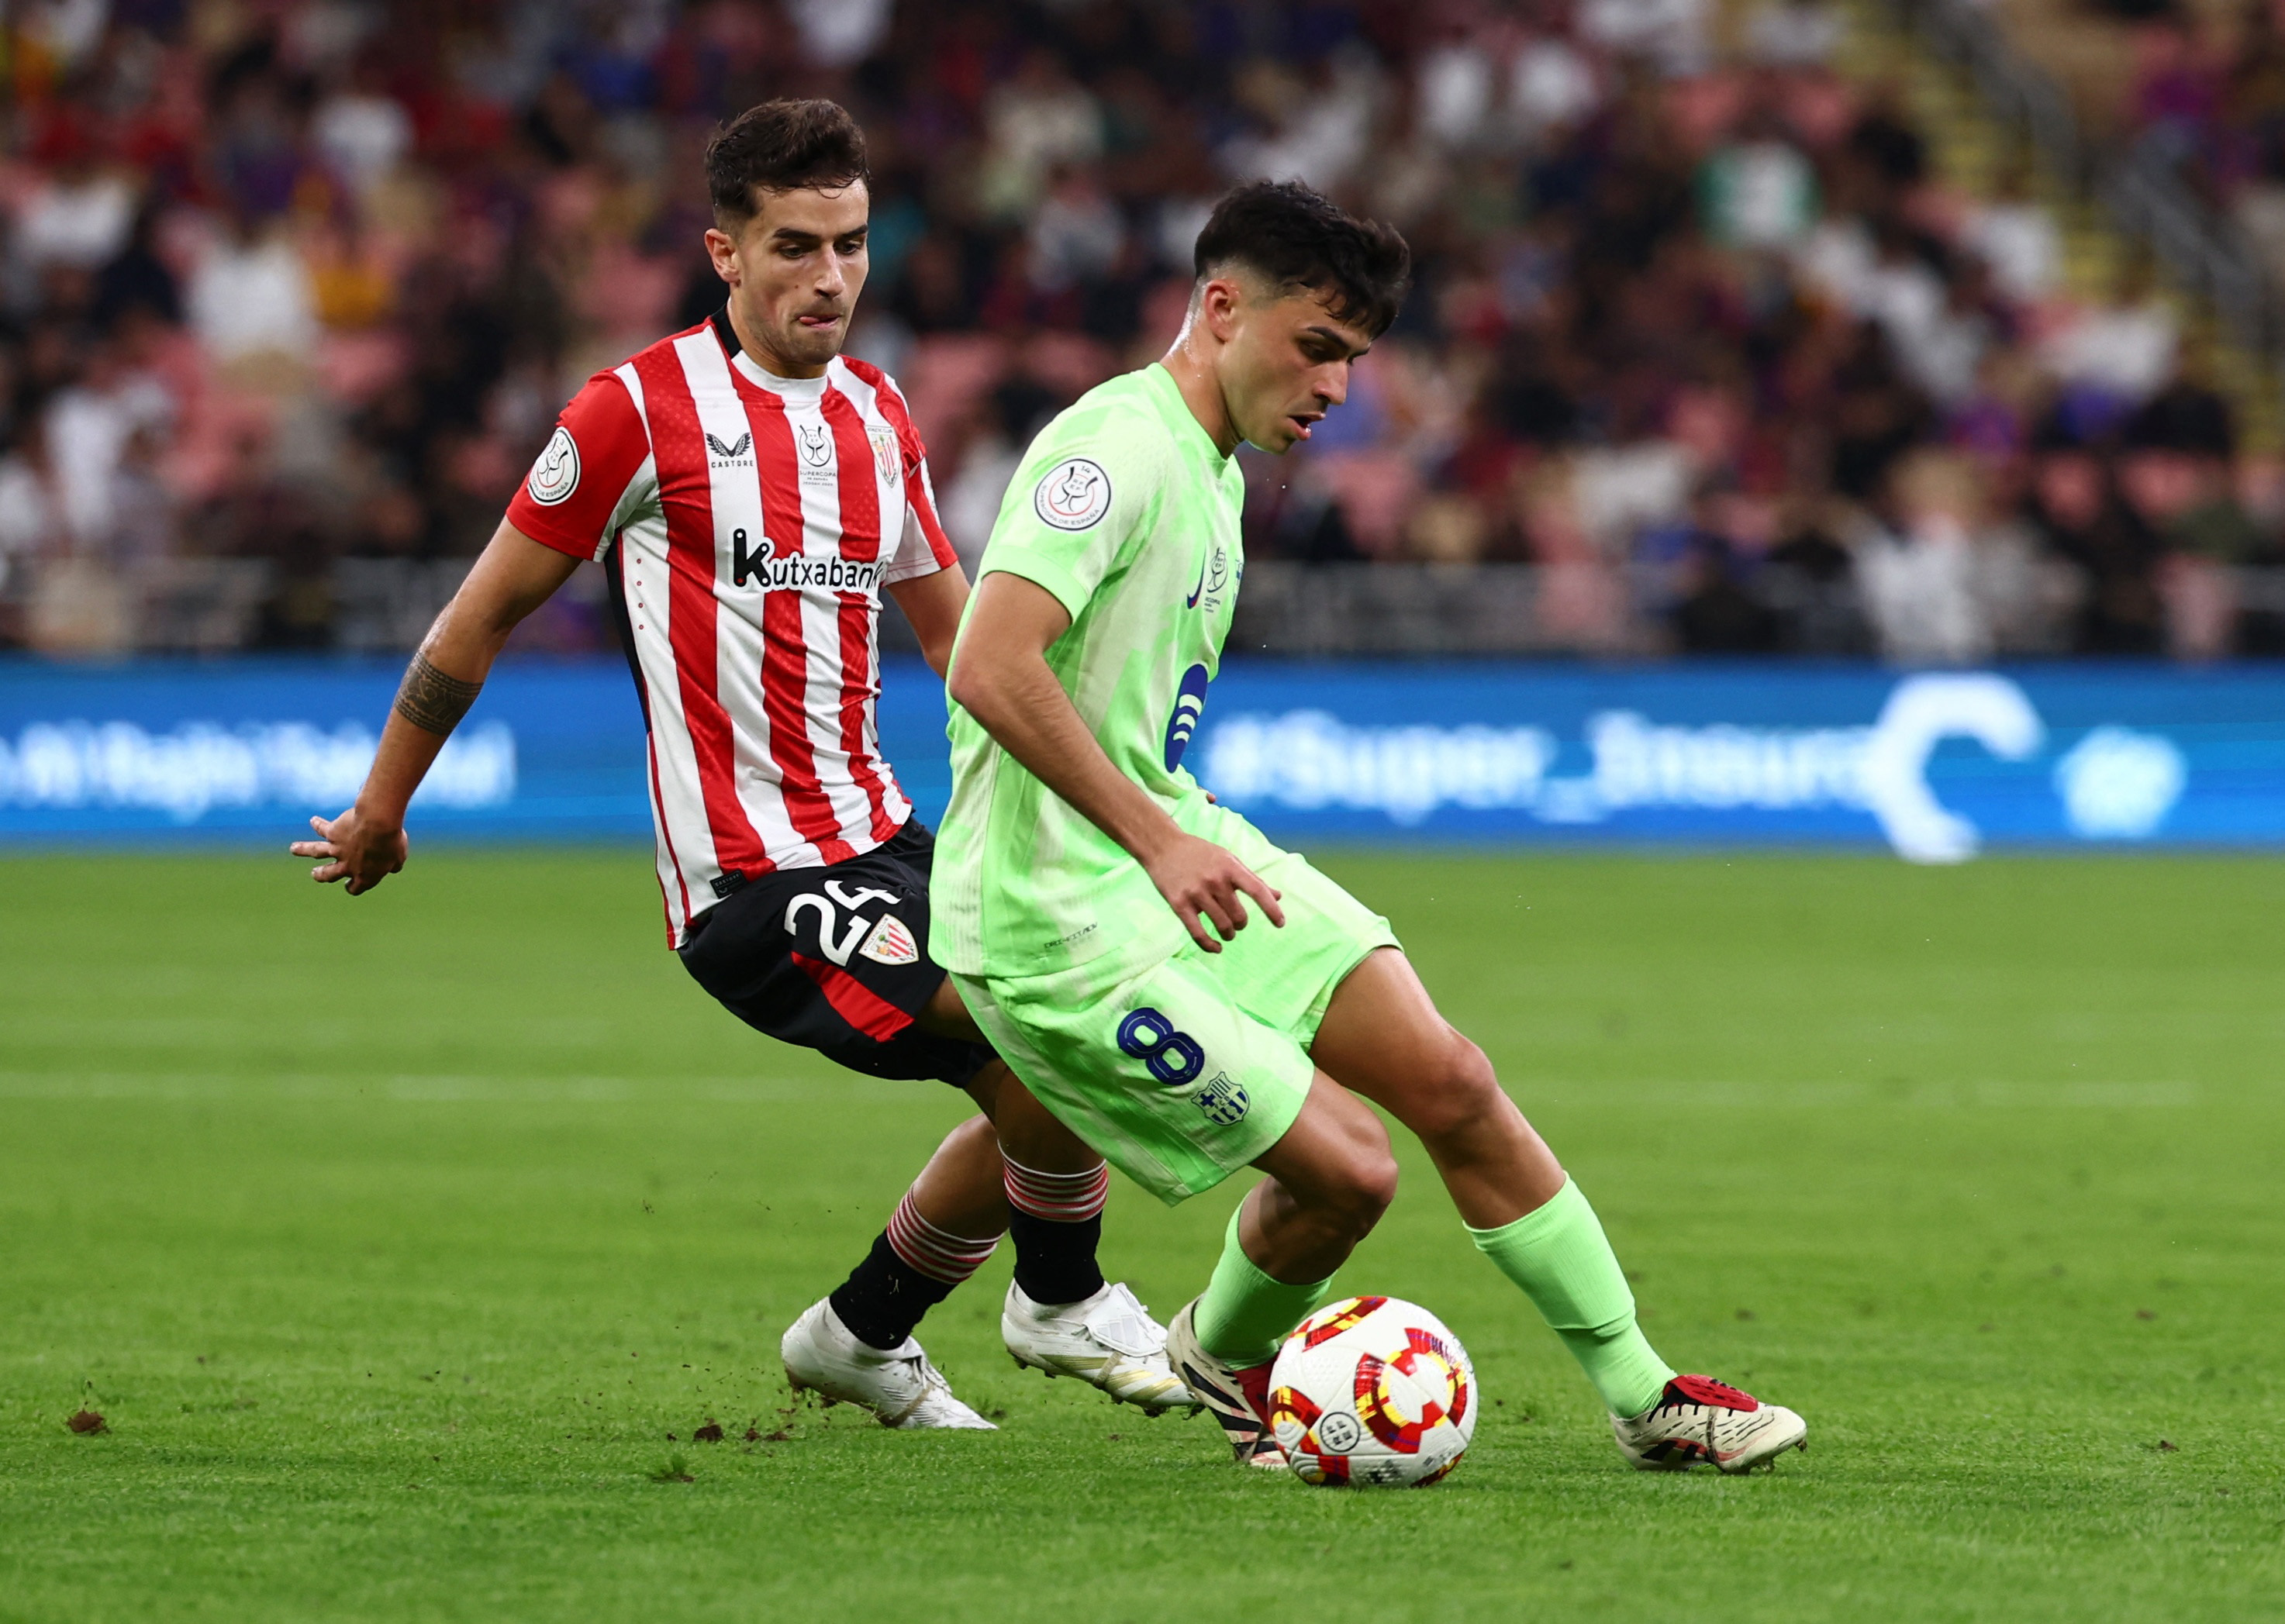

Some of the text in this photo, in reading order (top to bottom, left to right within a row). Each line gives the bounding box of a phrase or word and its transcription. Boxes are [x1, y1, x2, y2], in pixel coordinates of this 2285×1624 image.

[711, 460, 754, 468] CASTORE
[545, 481, 570, 498] ESPAÑA
[1070, 509, 1100, 526] ESPAÑA
[733, 528, 884, 589] Kutxabank
[784, 879, 903, 967] 24
[1117, 1007, 1205, 1086] 8
